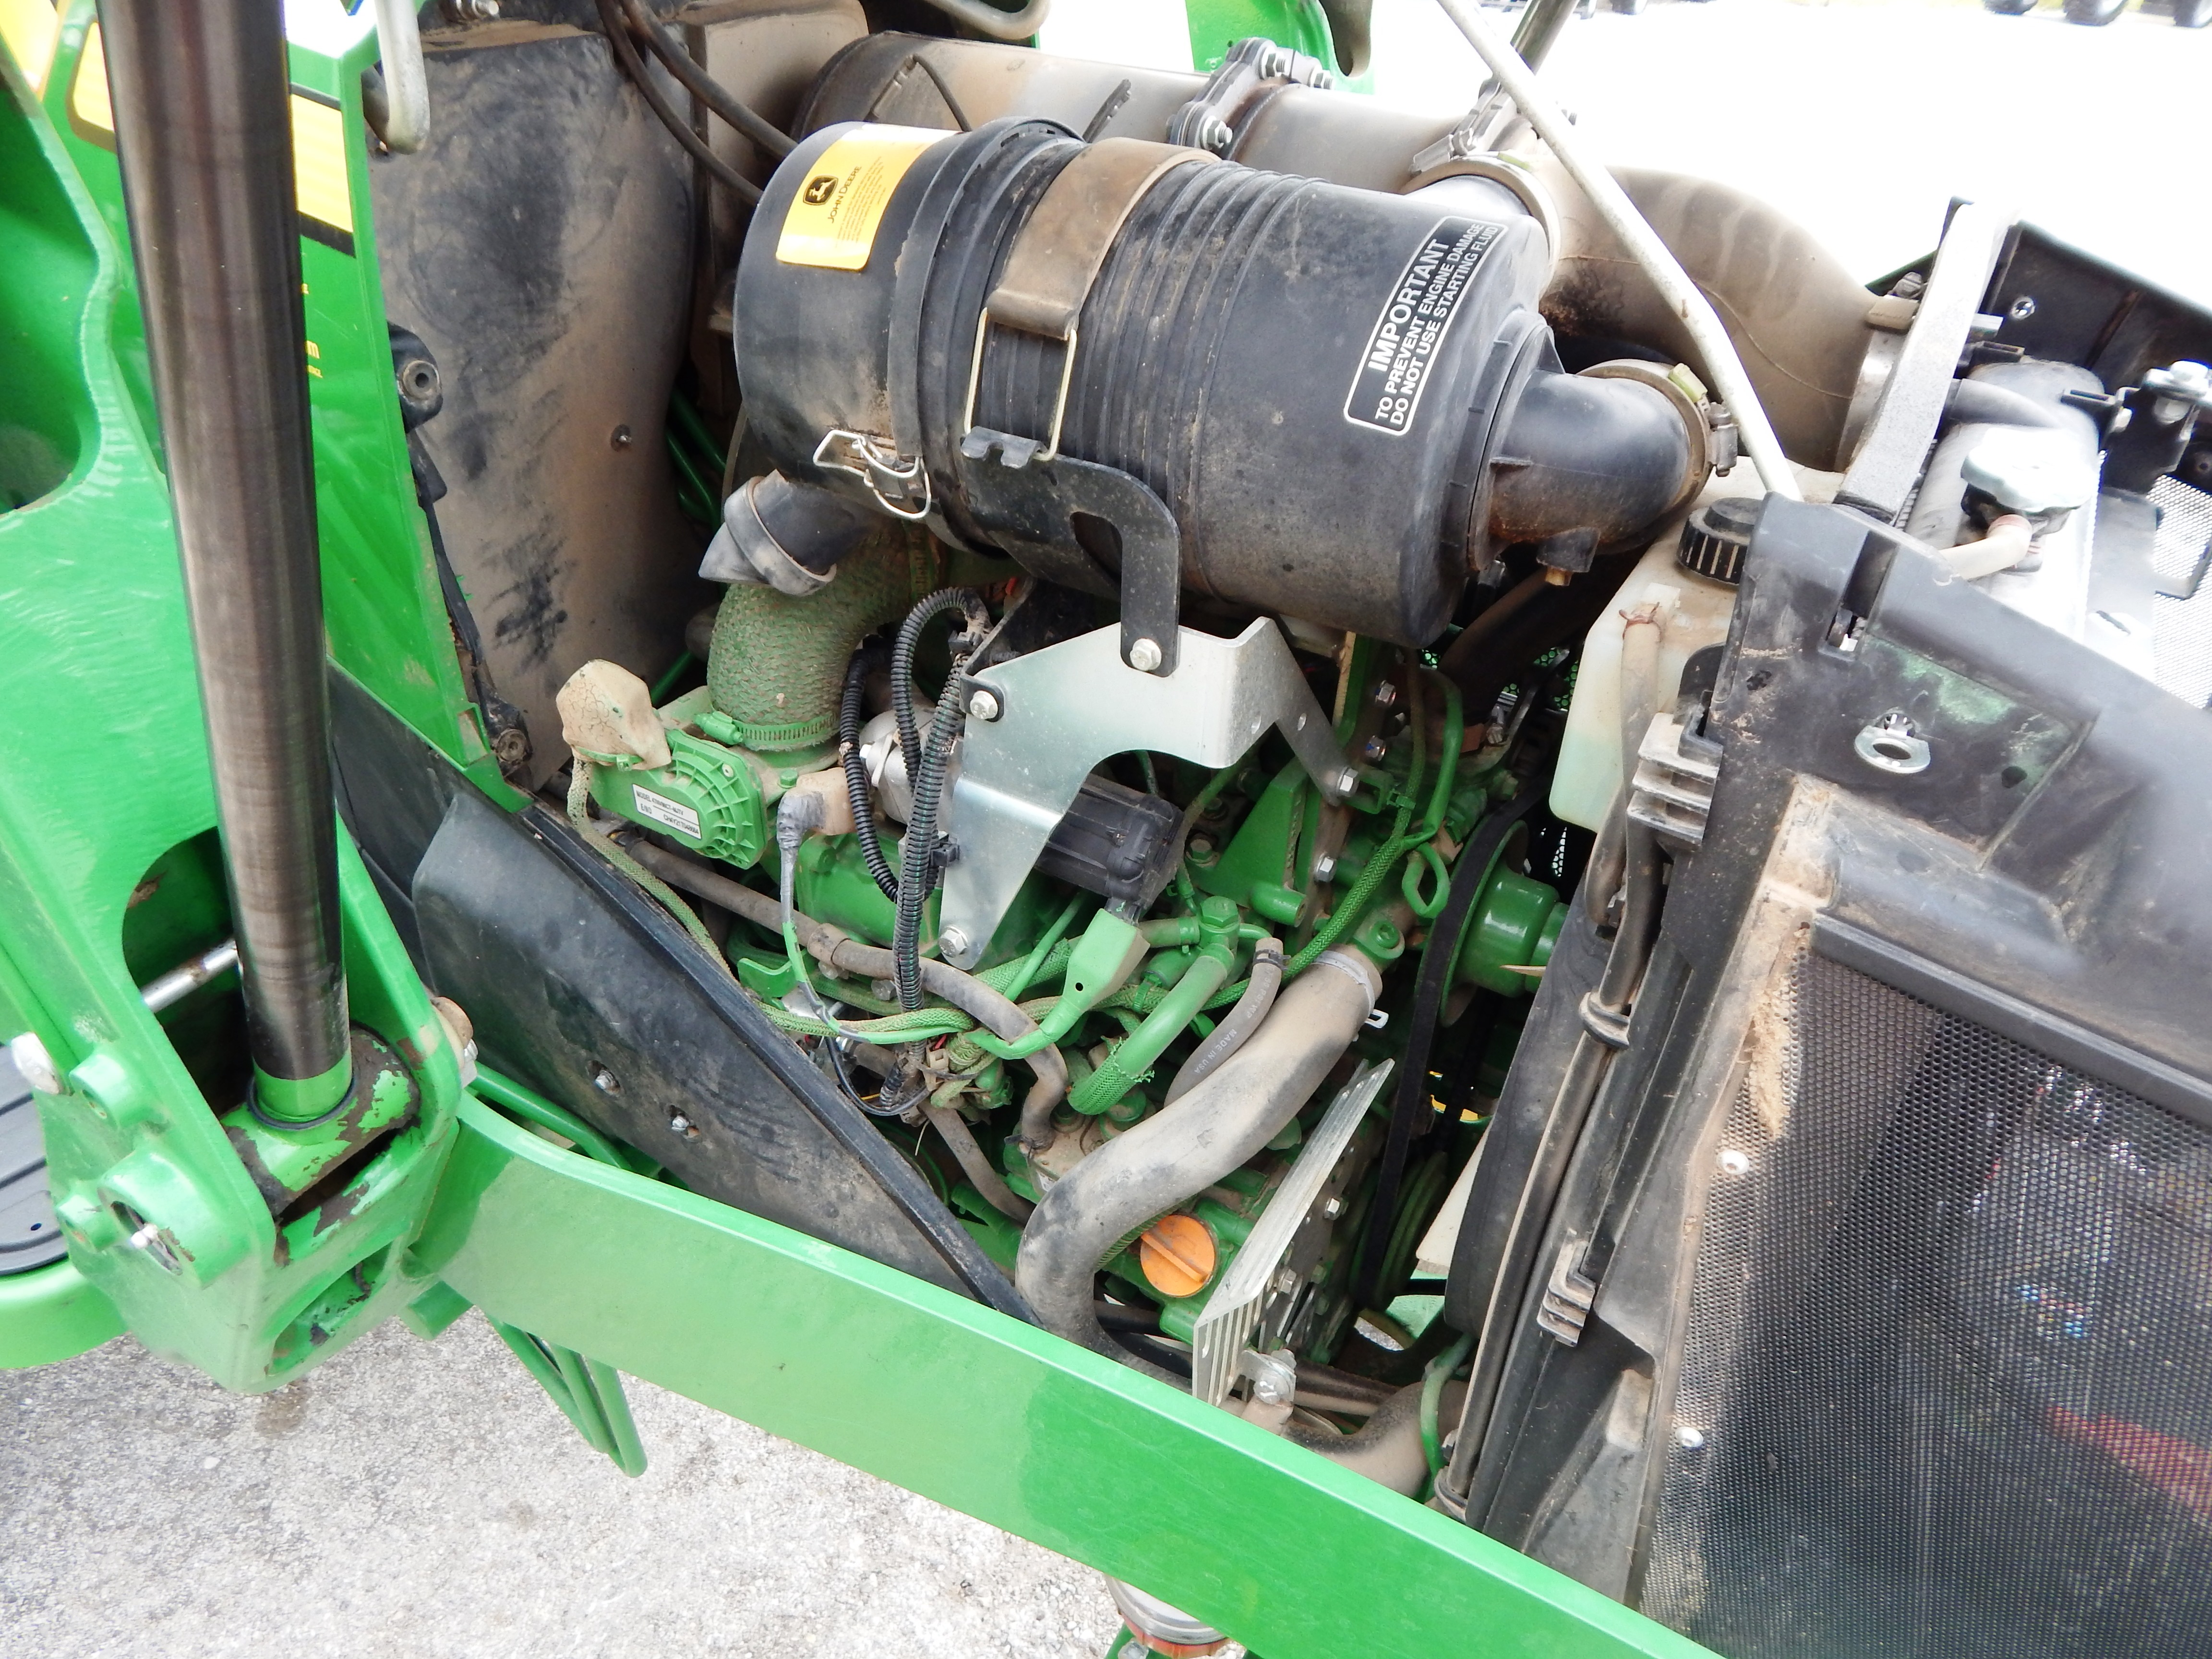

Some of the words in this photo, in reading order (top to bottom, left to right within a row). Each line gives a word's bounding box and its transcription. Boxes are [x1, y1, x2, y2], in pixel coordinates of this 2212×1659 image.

[827, 194, 843, 223] JOHN
[840, 166, 862, 194] DEERE
[1368, 239, 1449, 372] IMPORTANT
[1375, 397, 1393, 420] TO
[1385, 316, 1425, 394] PREVENT
[1418, 263, 1454, 314] ENGINE
[1447, 223, 1484, 264] DAMAGE
[1390, 398, 1408, 425] DO
[1403, 361, 1424, 394] NOT
[1419, 322, 1441, 354] USE
[1433, 253, 1479, 318] STARTING
[1471, 227, 1498, 256] FLUID
[637, 790, 651, 802] MODEL
[1208, 1050, 1216, 1059] IN
[1215, 1029, 1237, 1051] MADE
[1194, 1059, 1209, 1074] USA
